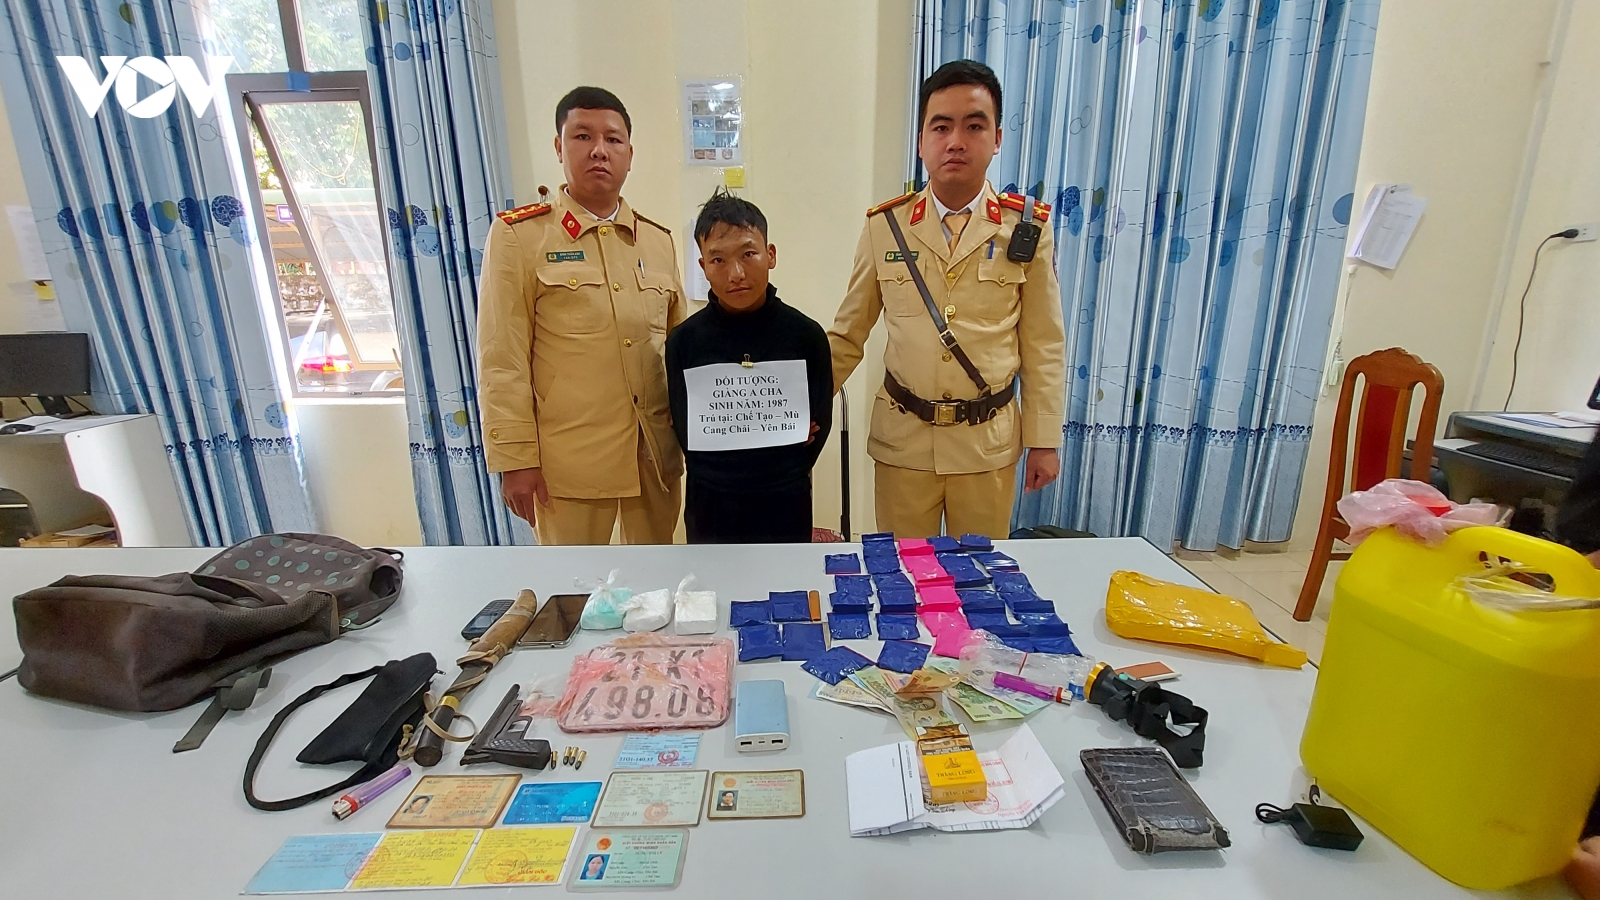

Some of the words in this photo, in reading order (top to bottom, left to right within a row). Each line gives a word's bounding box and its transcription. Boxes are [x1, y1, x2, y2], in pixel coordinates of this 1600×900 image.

[715, 376, 734, 387] ĐỐI
[737, 375, 779, 387] TƯỢNG:
[749, 389, 758, 397] A
[759, 387, 783, 396] CHA
[708, 402, 734, 411] SINH
[736, 399, 765, 410] NĂM:
[768, 399, 788, 408] 1987
[699, 414, 716, 423] Trú
[718, 414, 733, 424] tại:
[735, 410, 754, 421] Chế
[756, 411, 774, 421] Tạo
[703, 426, 727, 436] Cang
[760, 423, 778, 432] Yên
[781, 422, 796, 431] Bái
